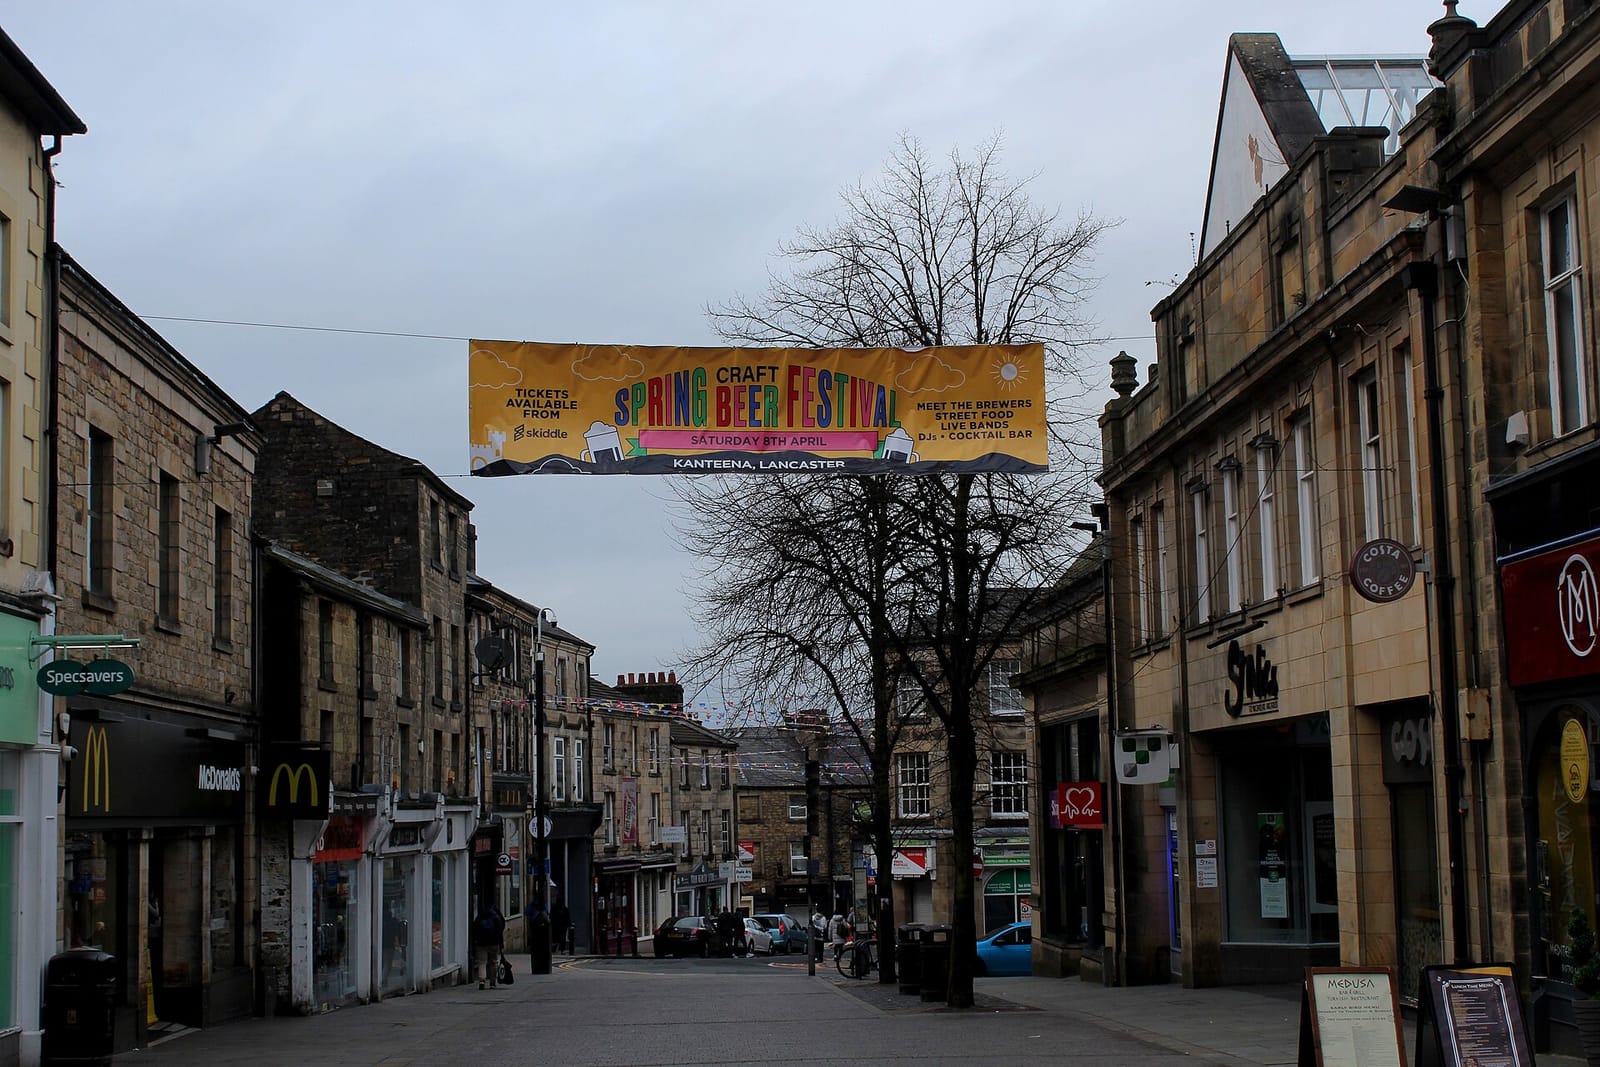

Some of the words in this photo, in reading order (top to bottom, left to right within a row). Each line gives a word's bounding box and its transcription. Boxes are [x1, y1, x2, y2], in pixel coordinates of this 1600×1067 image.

[716, 366, 779, 383] CRAFT
[515, 388, 569, 399] TICKETS
[614, 366, 708, 428] SPRING
[716, 384, 779, 428] BEER
[787, 364, 902, 429] FESTIVAL
[506, 398, 578, 410] AVAILABLE
[917, 402, 947, 411] MEET
[951, 401, 973, 410] THE
[976, 399, 1032, 409] BREWERS
[523, 409, 560, 420] FROM
[935, 411, 978, 421] STREET
[981, 410, 1014, 419] FOOD
[941, 421, 967, 431] LIVE
[970, 420, 1009, 430] BANDS
[526, 427, 568, 439] skiddle
[918, 433, 937, 441] DJs
[949, 431, 1006, 441] COCKTAIL
[1009, 430, 1032, 439] BAR
[691, 435, 760, 446] SATURDAY
[763, 436, 786, 446] 8TH
[790, 436, 827, 446] APRIL
[673, 458, 756, 470] KANTEENA,
[759, 460, 846, 470] LANCASTER
[1363, 545, 1401, 562] COSTA
[1363, 575, 1409, 596] COFFEE
[46, 670, 124, 686] Specsavers
[198, 764, 241, 792] McDonald's
[1328, 979, 1375, 989] MEDUSA
